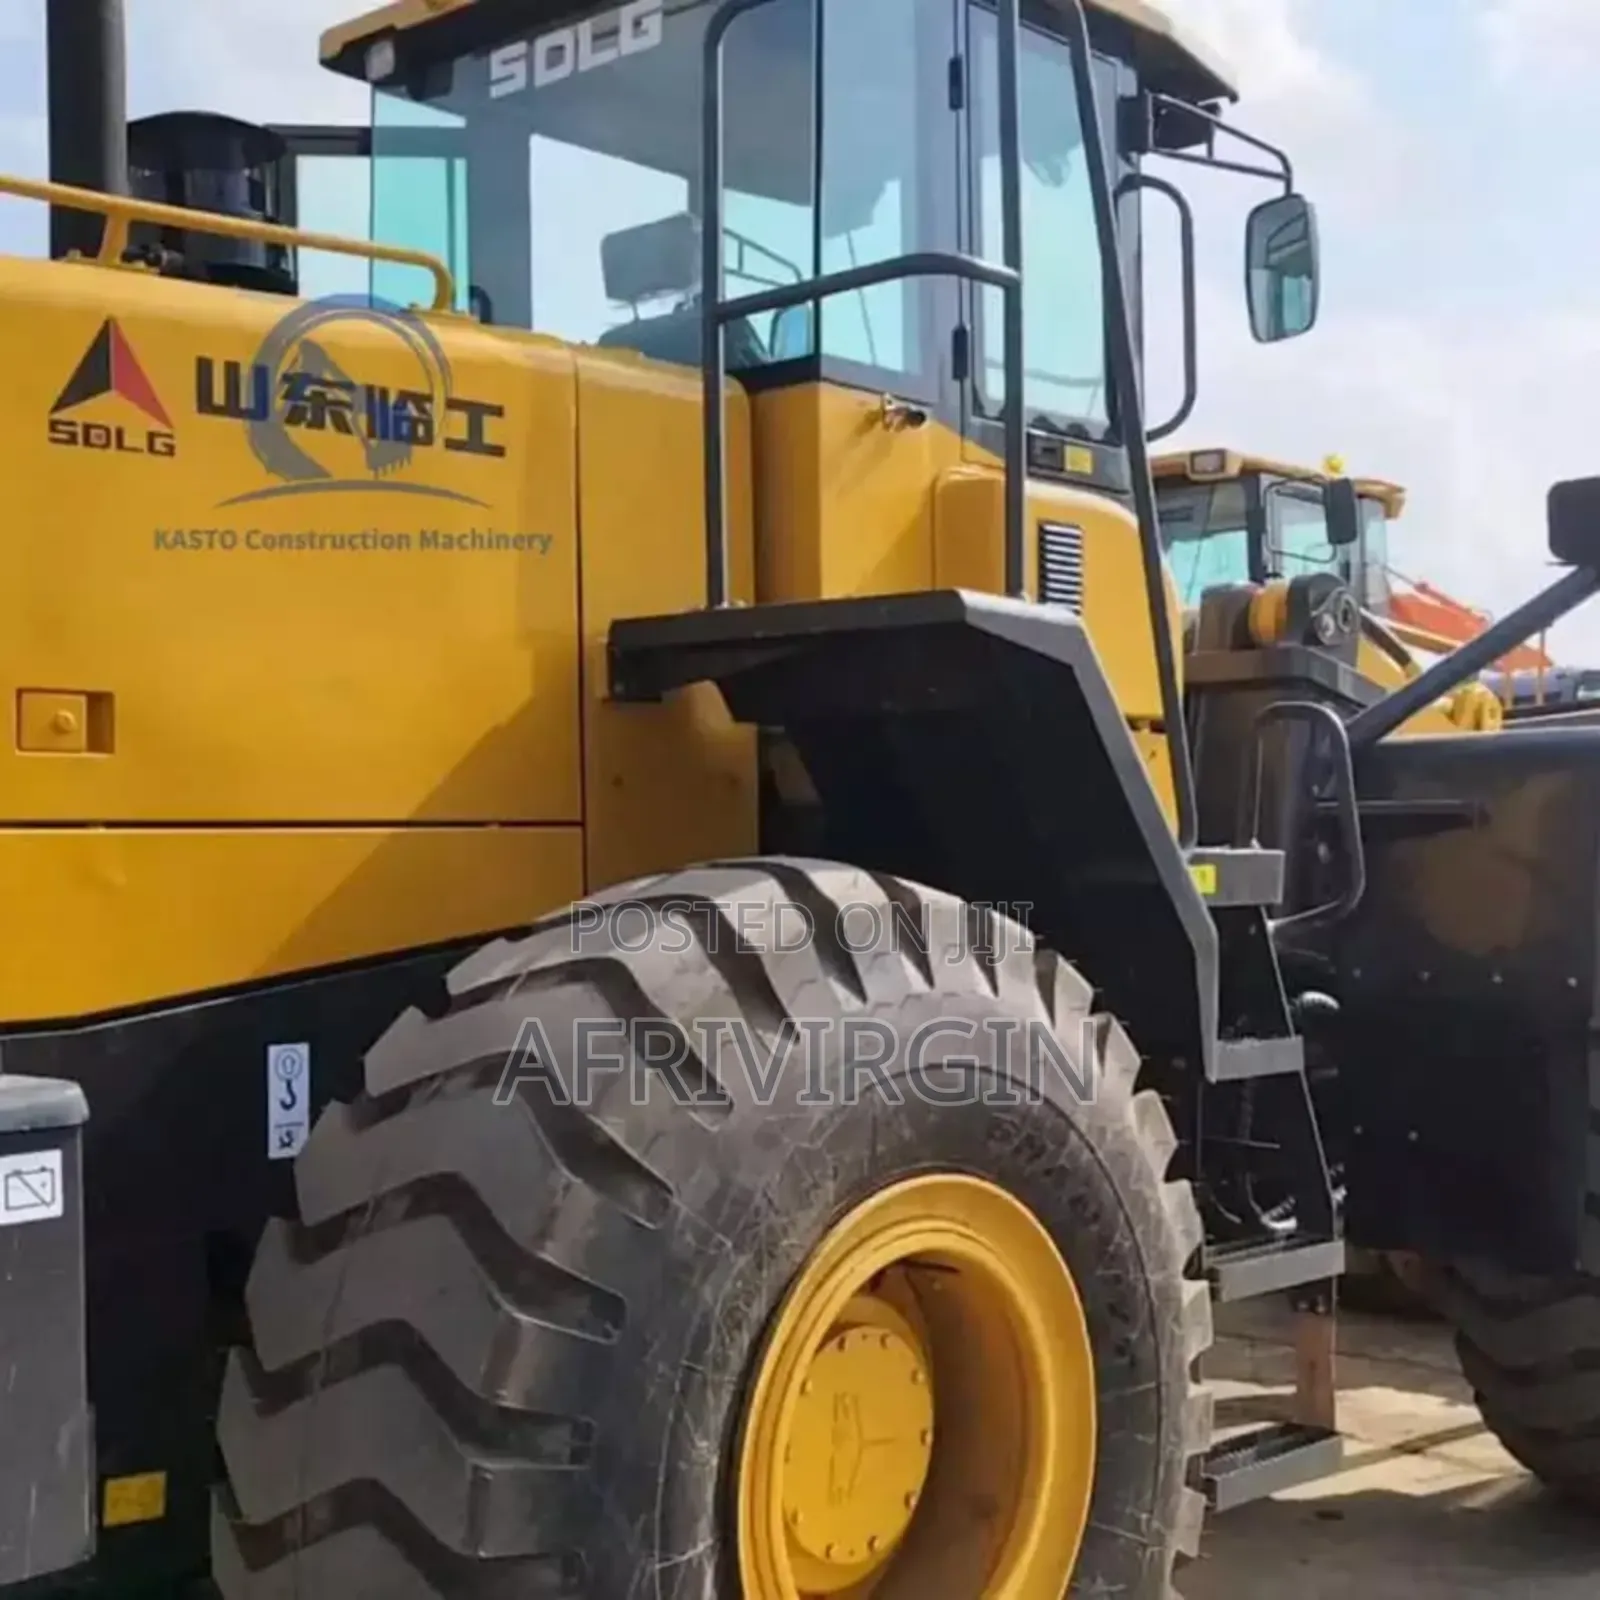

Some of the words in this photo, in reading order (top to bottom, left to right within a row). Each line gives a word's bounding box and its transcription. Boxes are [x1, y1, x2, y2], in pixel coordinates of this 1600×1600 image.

[48, 419, 176, 457] SDLG
[195, 356, 506, 457] 山东临工
